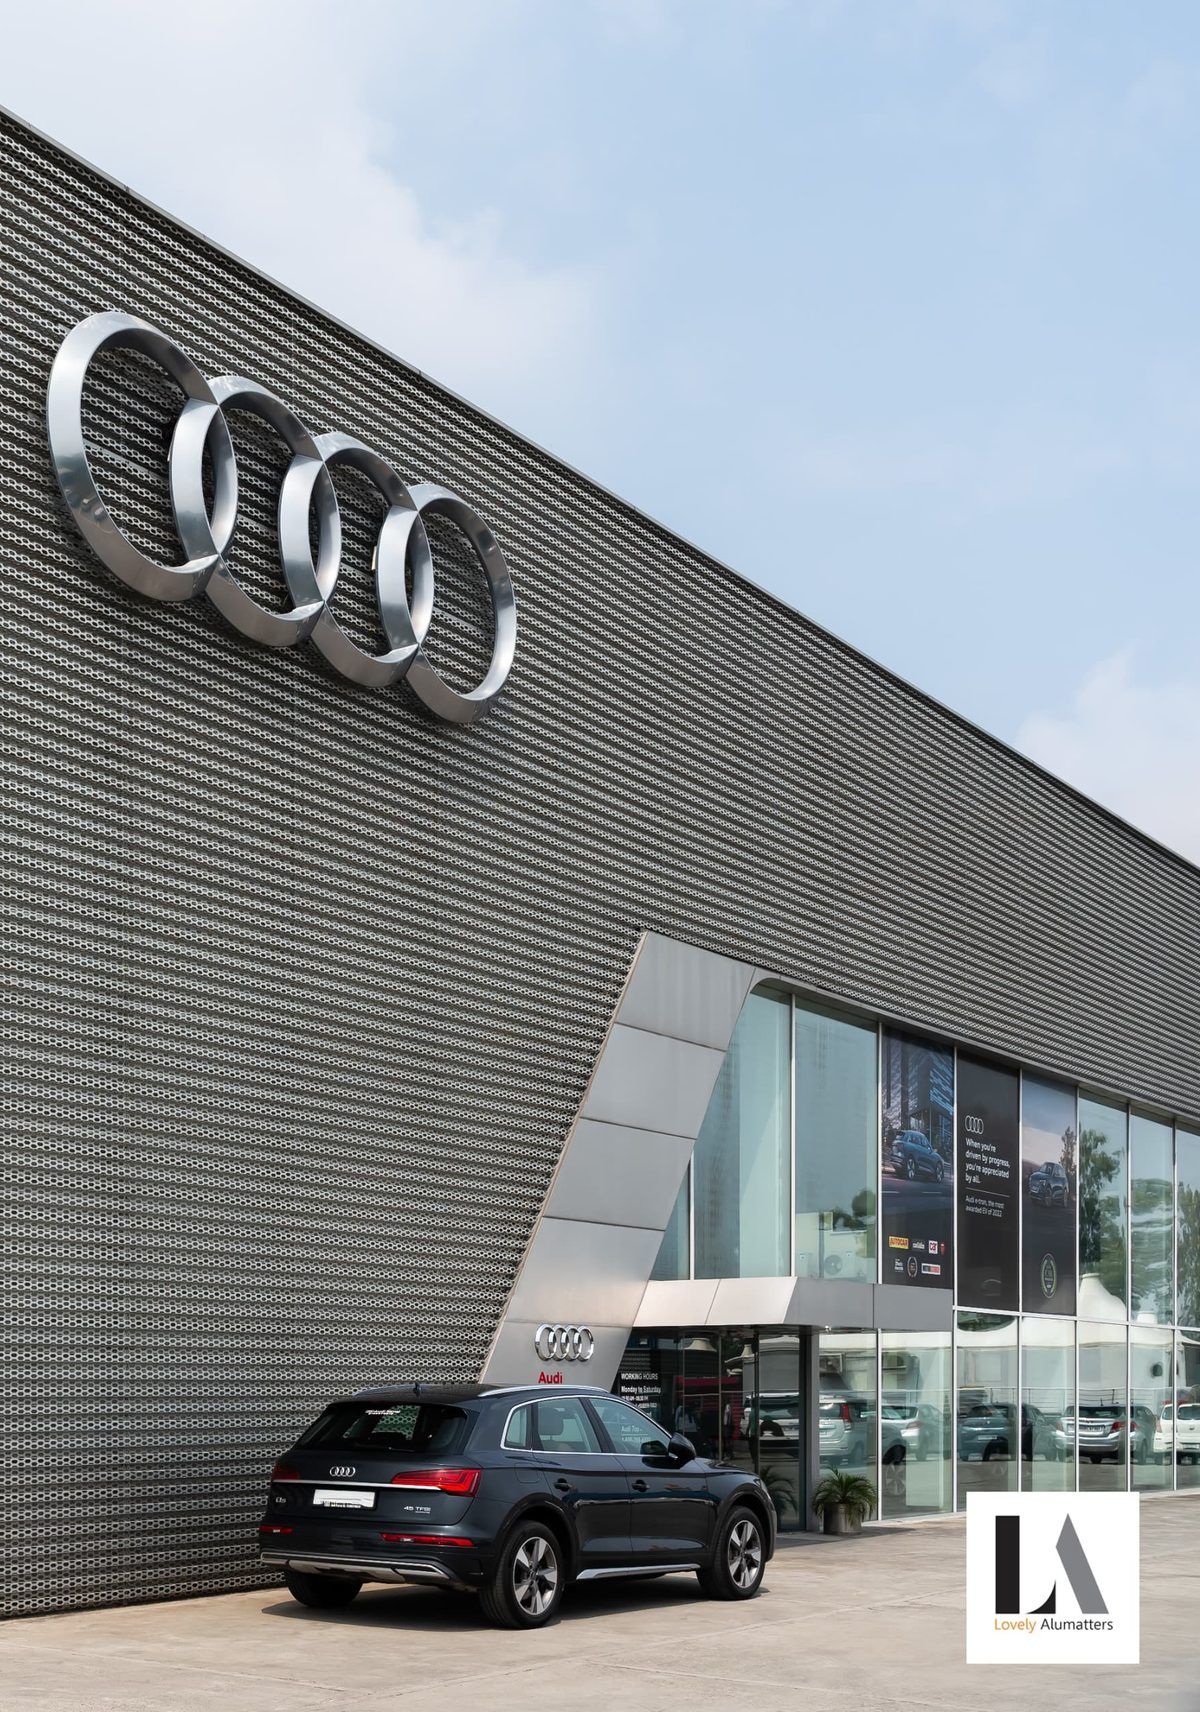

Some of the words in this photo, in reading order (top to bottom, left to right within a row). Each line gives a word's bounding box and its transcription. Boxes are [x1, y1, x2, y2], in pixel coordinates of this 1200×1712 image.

[965, 1137, 980, 1149] When
[980, 1143, 997, 1152] you're
[965, 1150, 981, 1160] driven
[982, 1153, 988, 1164] by
[965, 1163, 981, 1172] you're
[981, 1166, 1009, 1179] appreciated
[965, 1172, 972, 1183] by
[538, 1371, 563, 1384] Audi
[621, 1386, 637, 1394] Monday
[643, 1386, 661, 1394] Saturday
